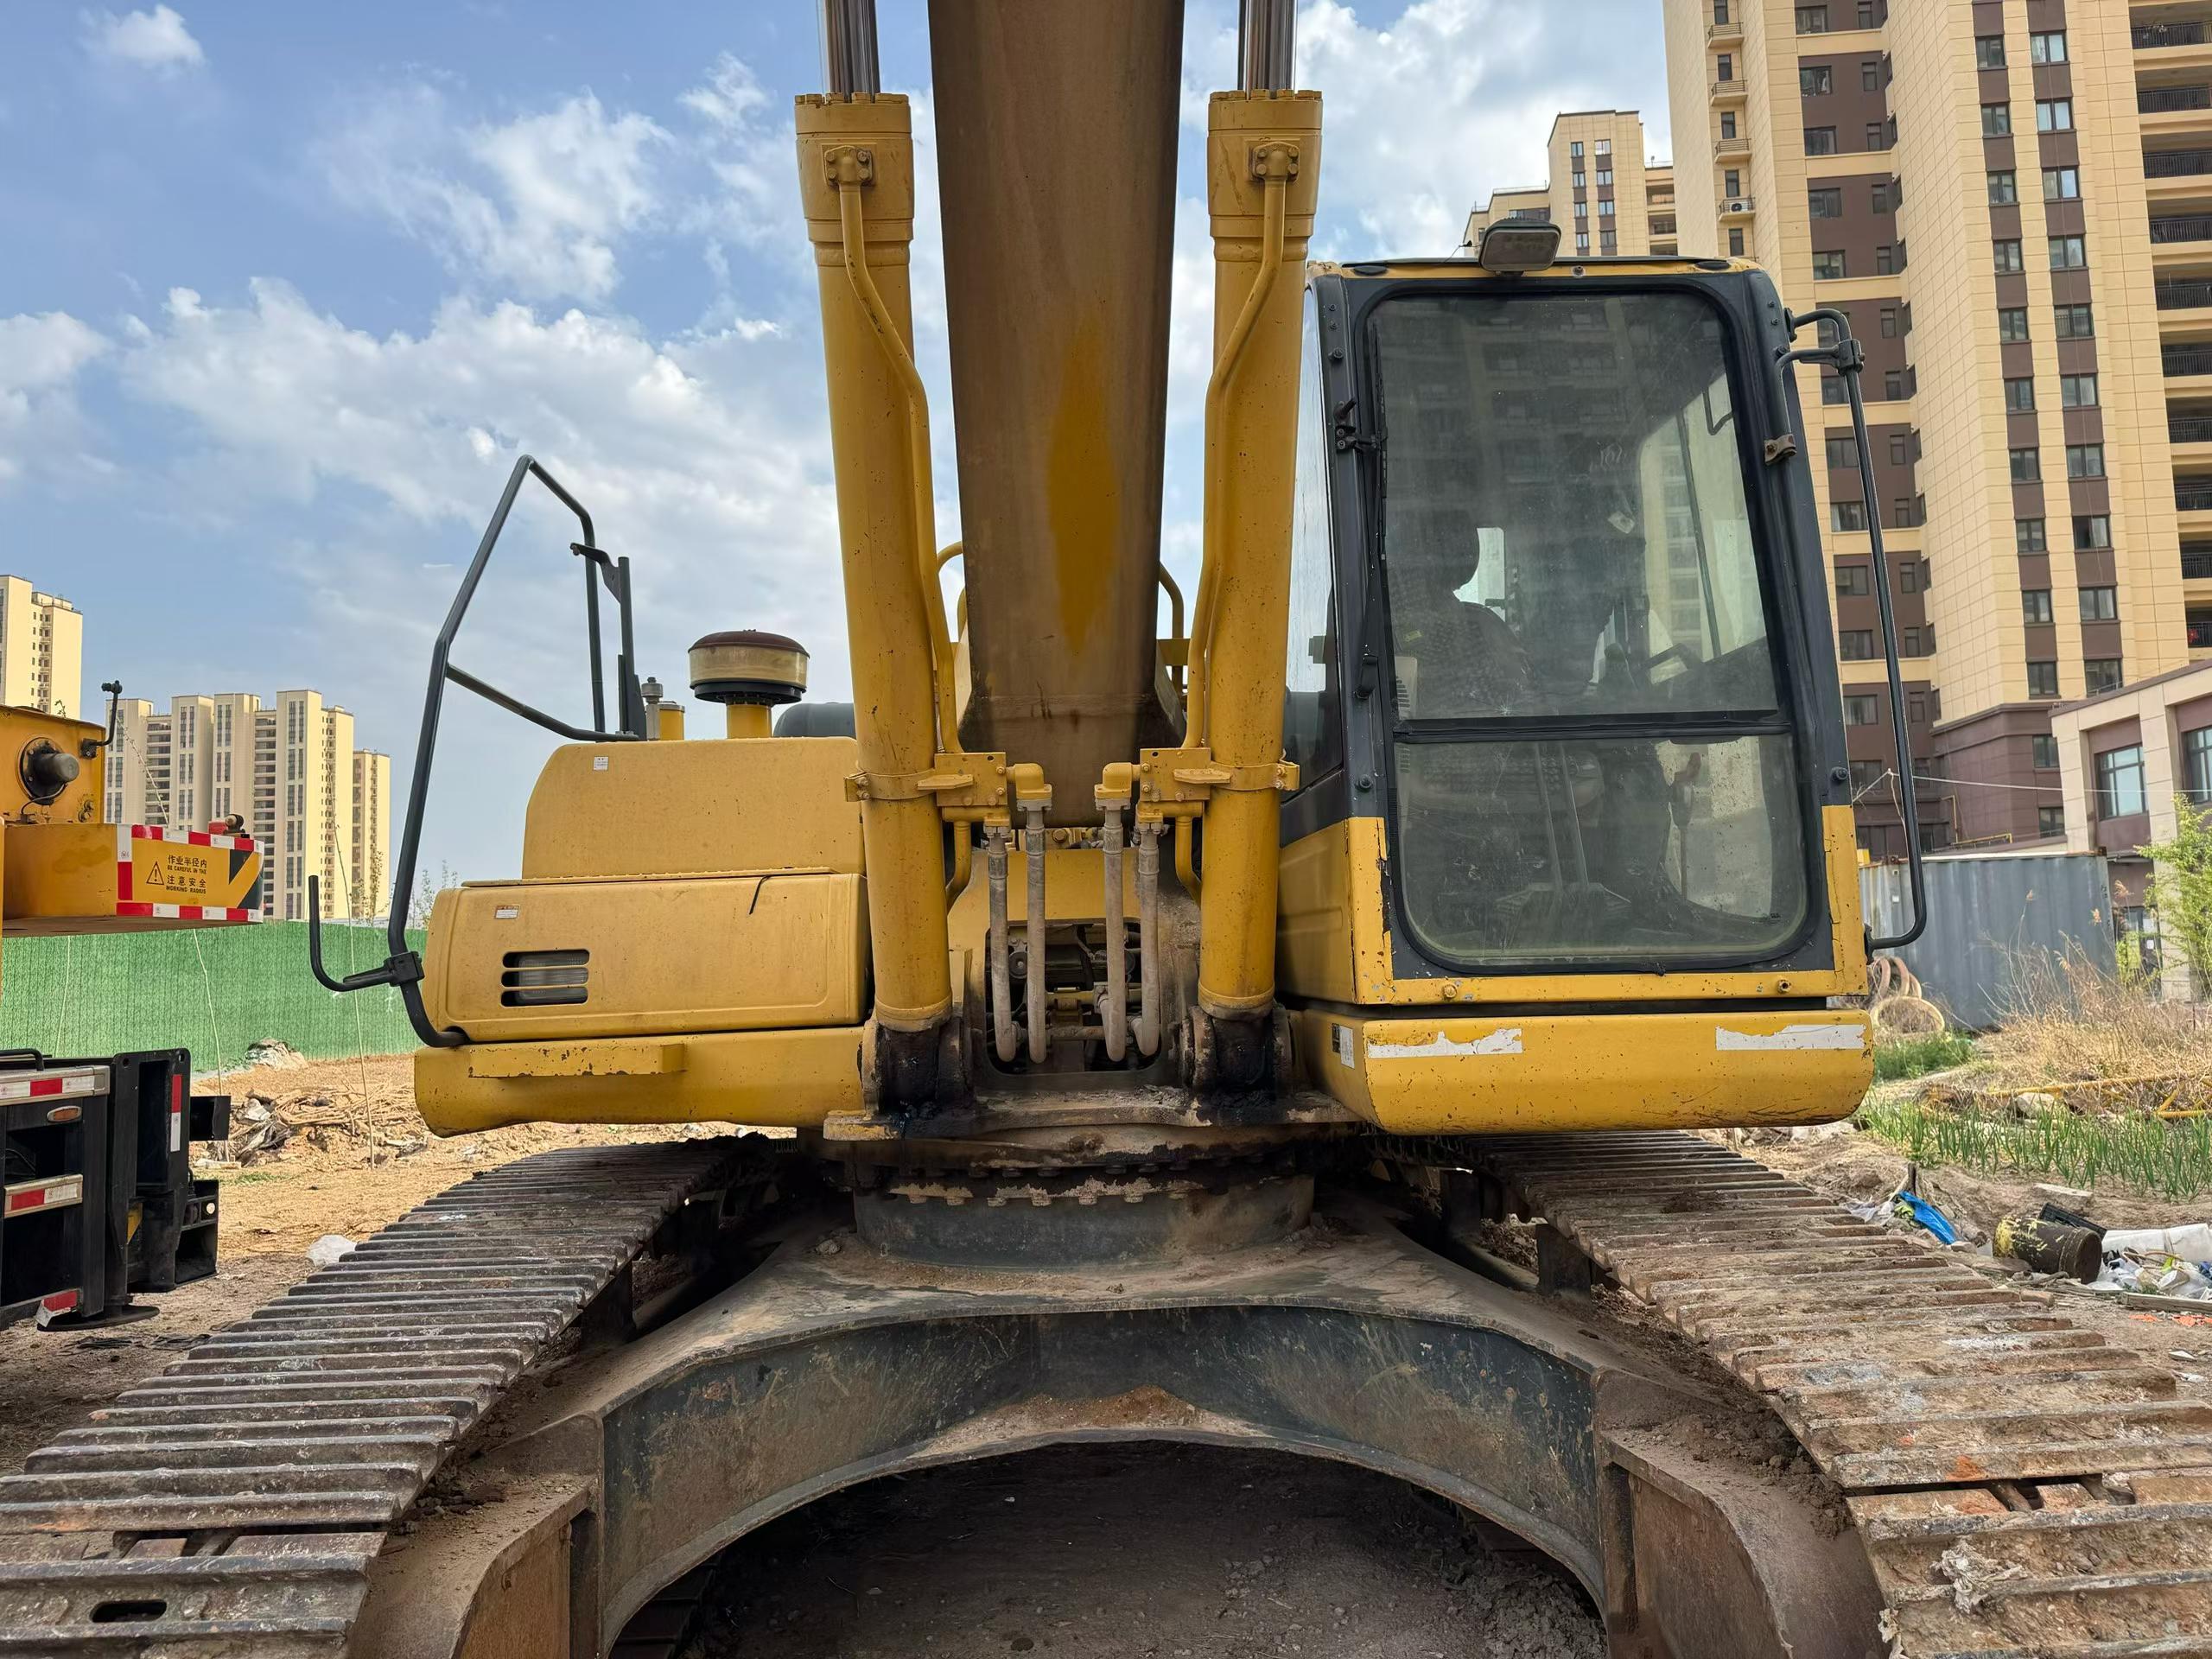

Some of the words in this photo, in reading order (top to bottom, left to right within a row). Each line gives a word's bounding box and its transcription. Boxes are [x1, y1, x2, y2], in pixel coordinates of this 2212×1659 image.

[168, 855, 207, 868] 作业半径内
[167, 874, 207, 888] 注意安全
